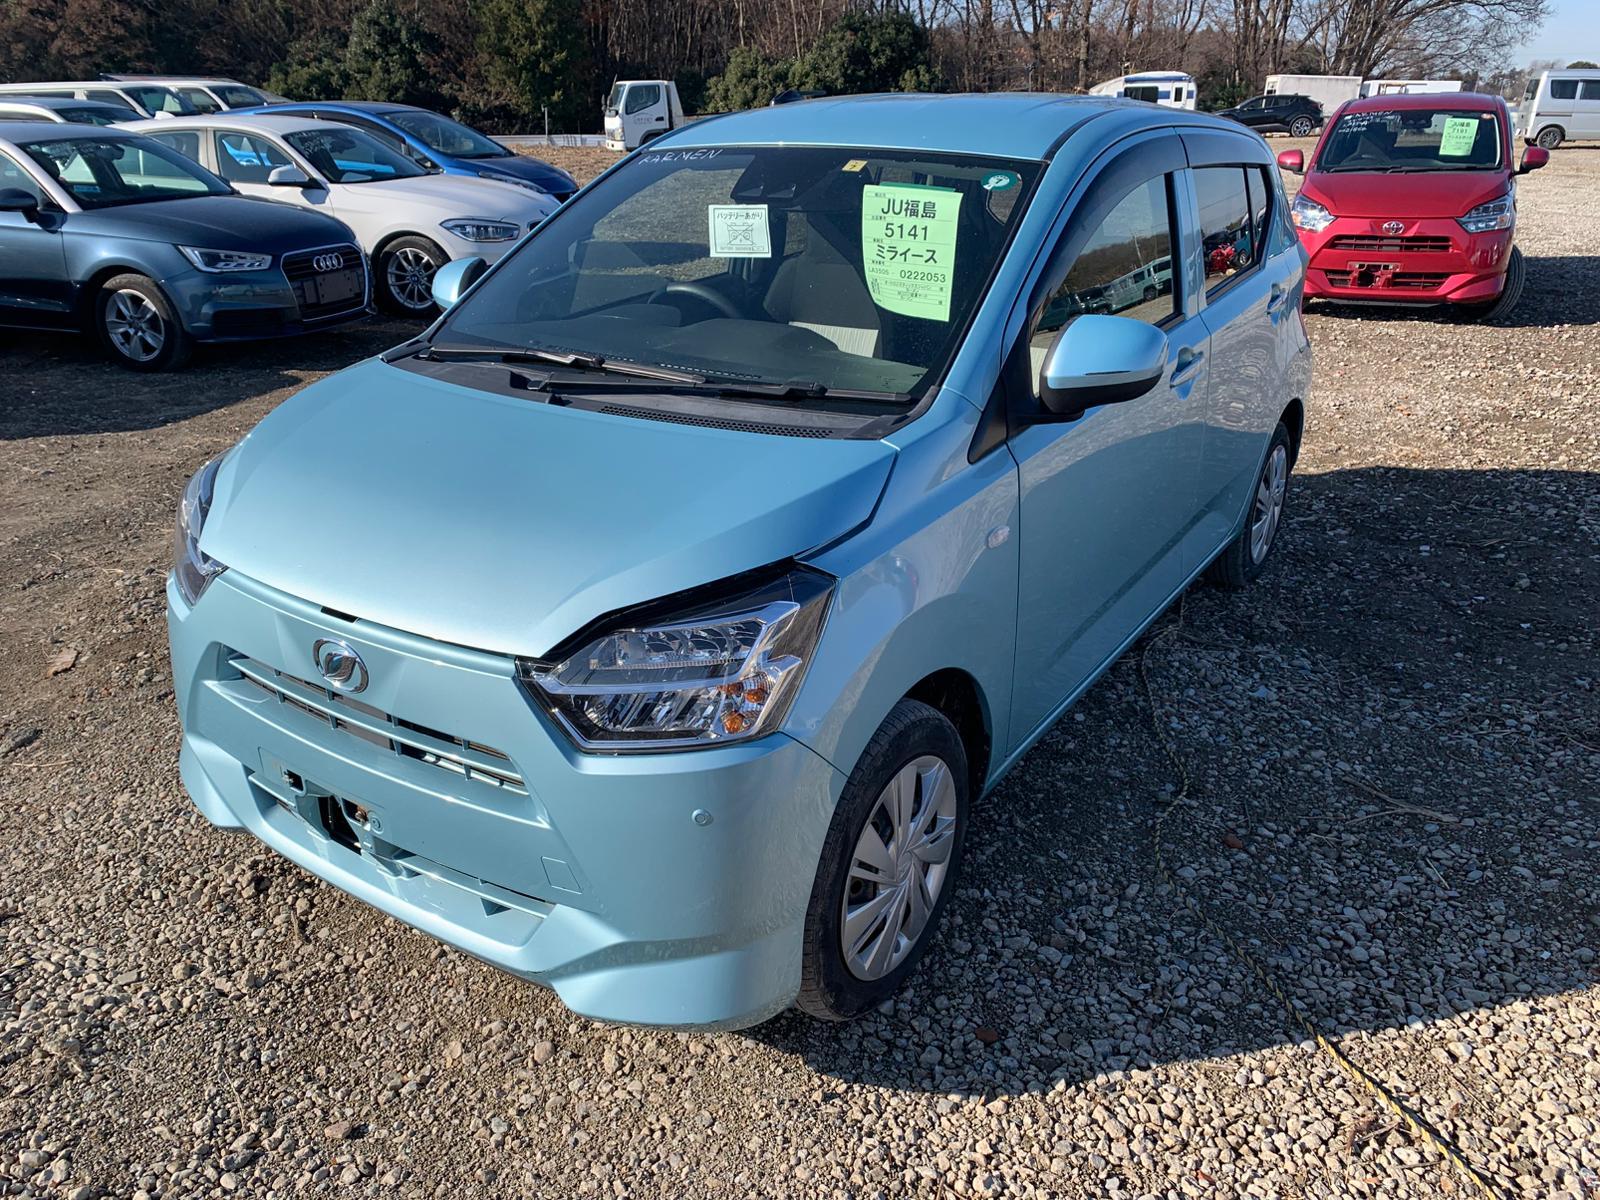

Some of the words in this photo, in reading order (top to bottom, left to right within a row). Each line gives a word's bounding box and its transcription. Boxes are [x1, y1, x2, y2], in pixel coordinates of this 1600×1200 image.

[638, 148, 724, 165] KARMEN
[881, 198, 937, 219] JU福島
[884, 222, 929, 241] 5141
[875, 244, 938, 264] ミライース
[899, 269, 946, 283] 0222053
